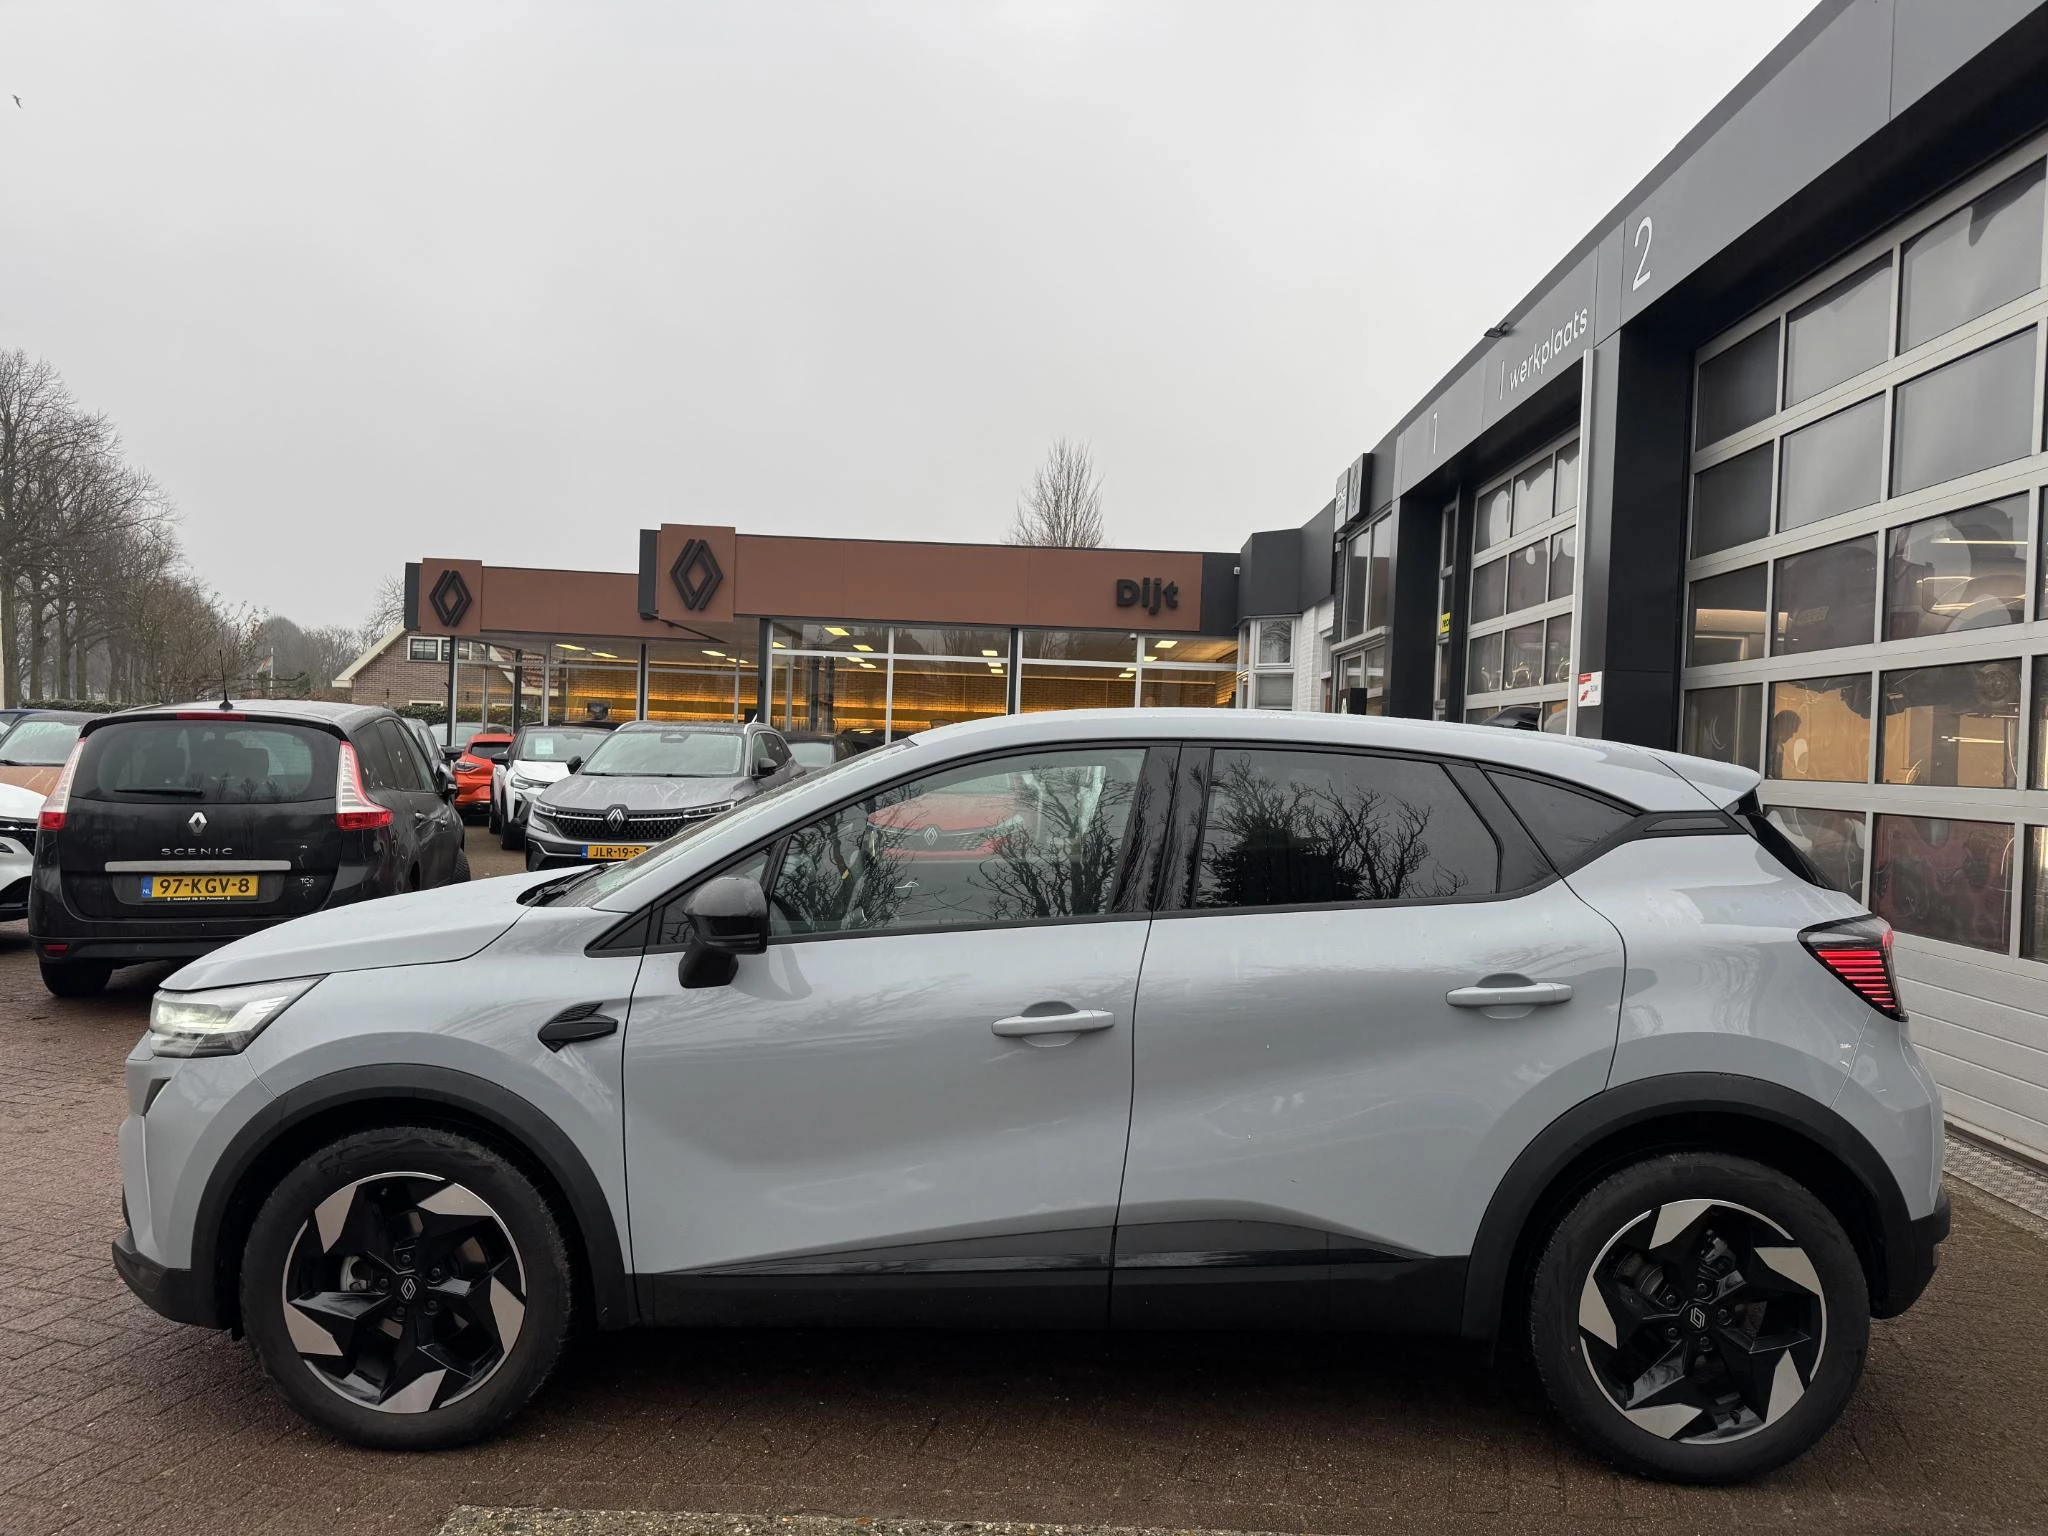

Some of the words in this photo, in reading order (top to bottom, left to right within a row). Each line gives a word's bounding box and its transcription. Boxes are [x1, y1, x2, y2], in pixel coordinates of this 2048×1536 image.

[1632, 216, 1653, 292] 2
[1509, 307, 1588, 392] werkplaats
[1433, 412, 1438, 455] 1
[1116, 577, 1179, 616] Dijt
[161, 847, 233, 856] SCENIC
[593, 847, 640, 858] JLR-19-S
[159, 878, 250, 895] 97-KGV-8
